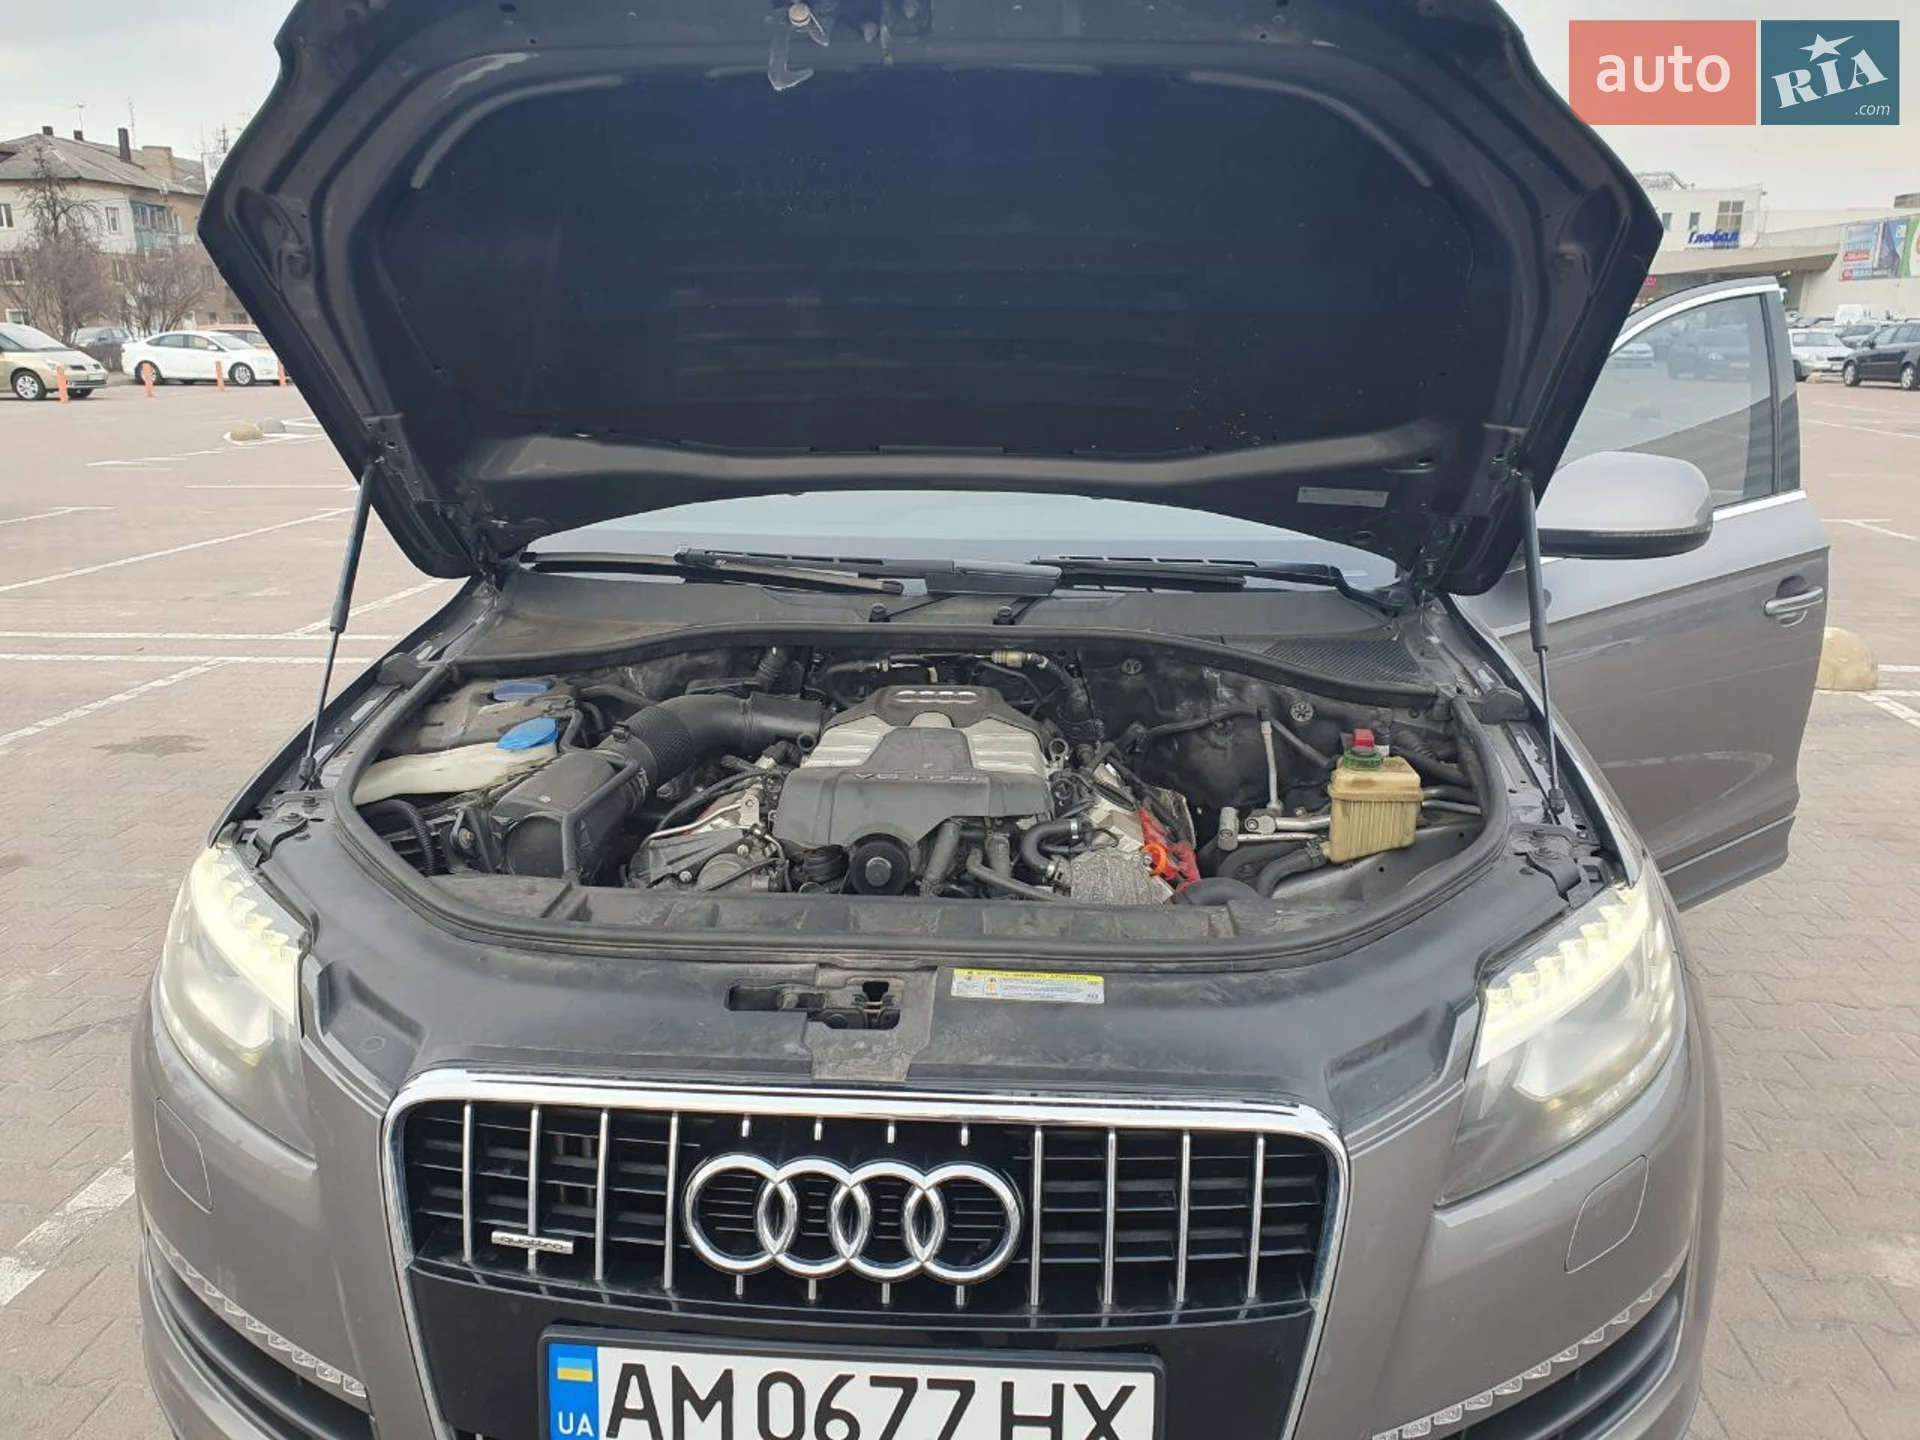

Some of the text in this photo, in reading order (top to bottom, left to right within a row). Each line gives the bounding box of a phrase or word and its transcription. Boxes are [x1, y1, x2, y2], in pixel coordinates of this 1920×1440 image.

[500, 1235, 565, 1251] quattro
[605, 1362, 1137, 1440] AM 0677 HX
[558, 1411, 595, 1437] UA
